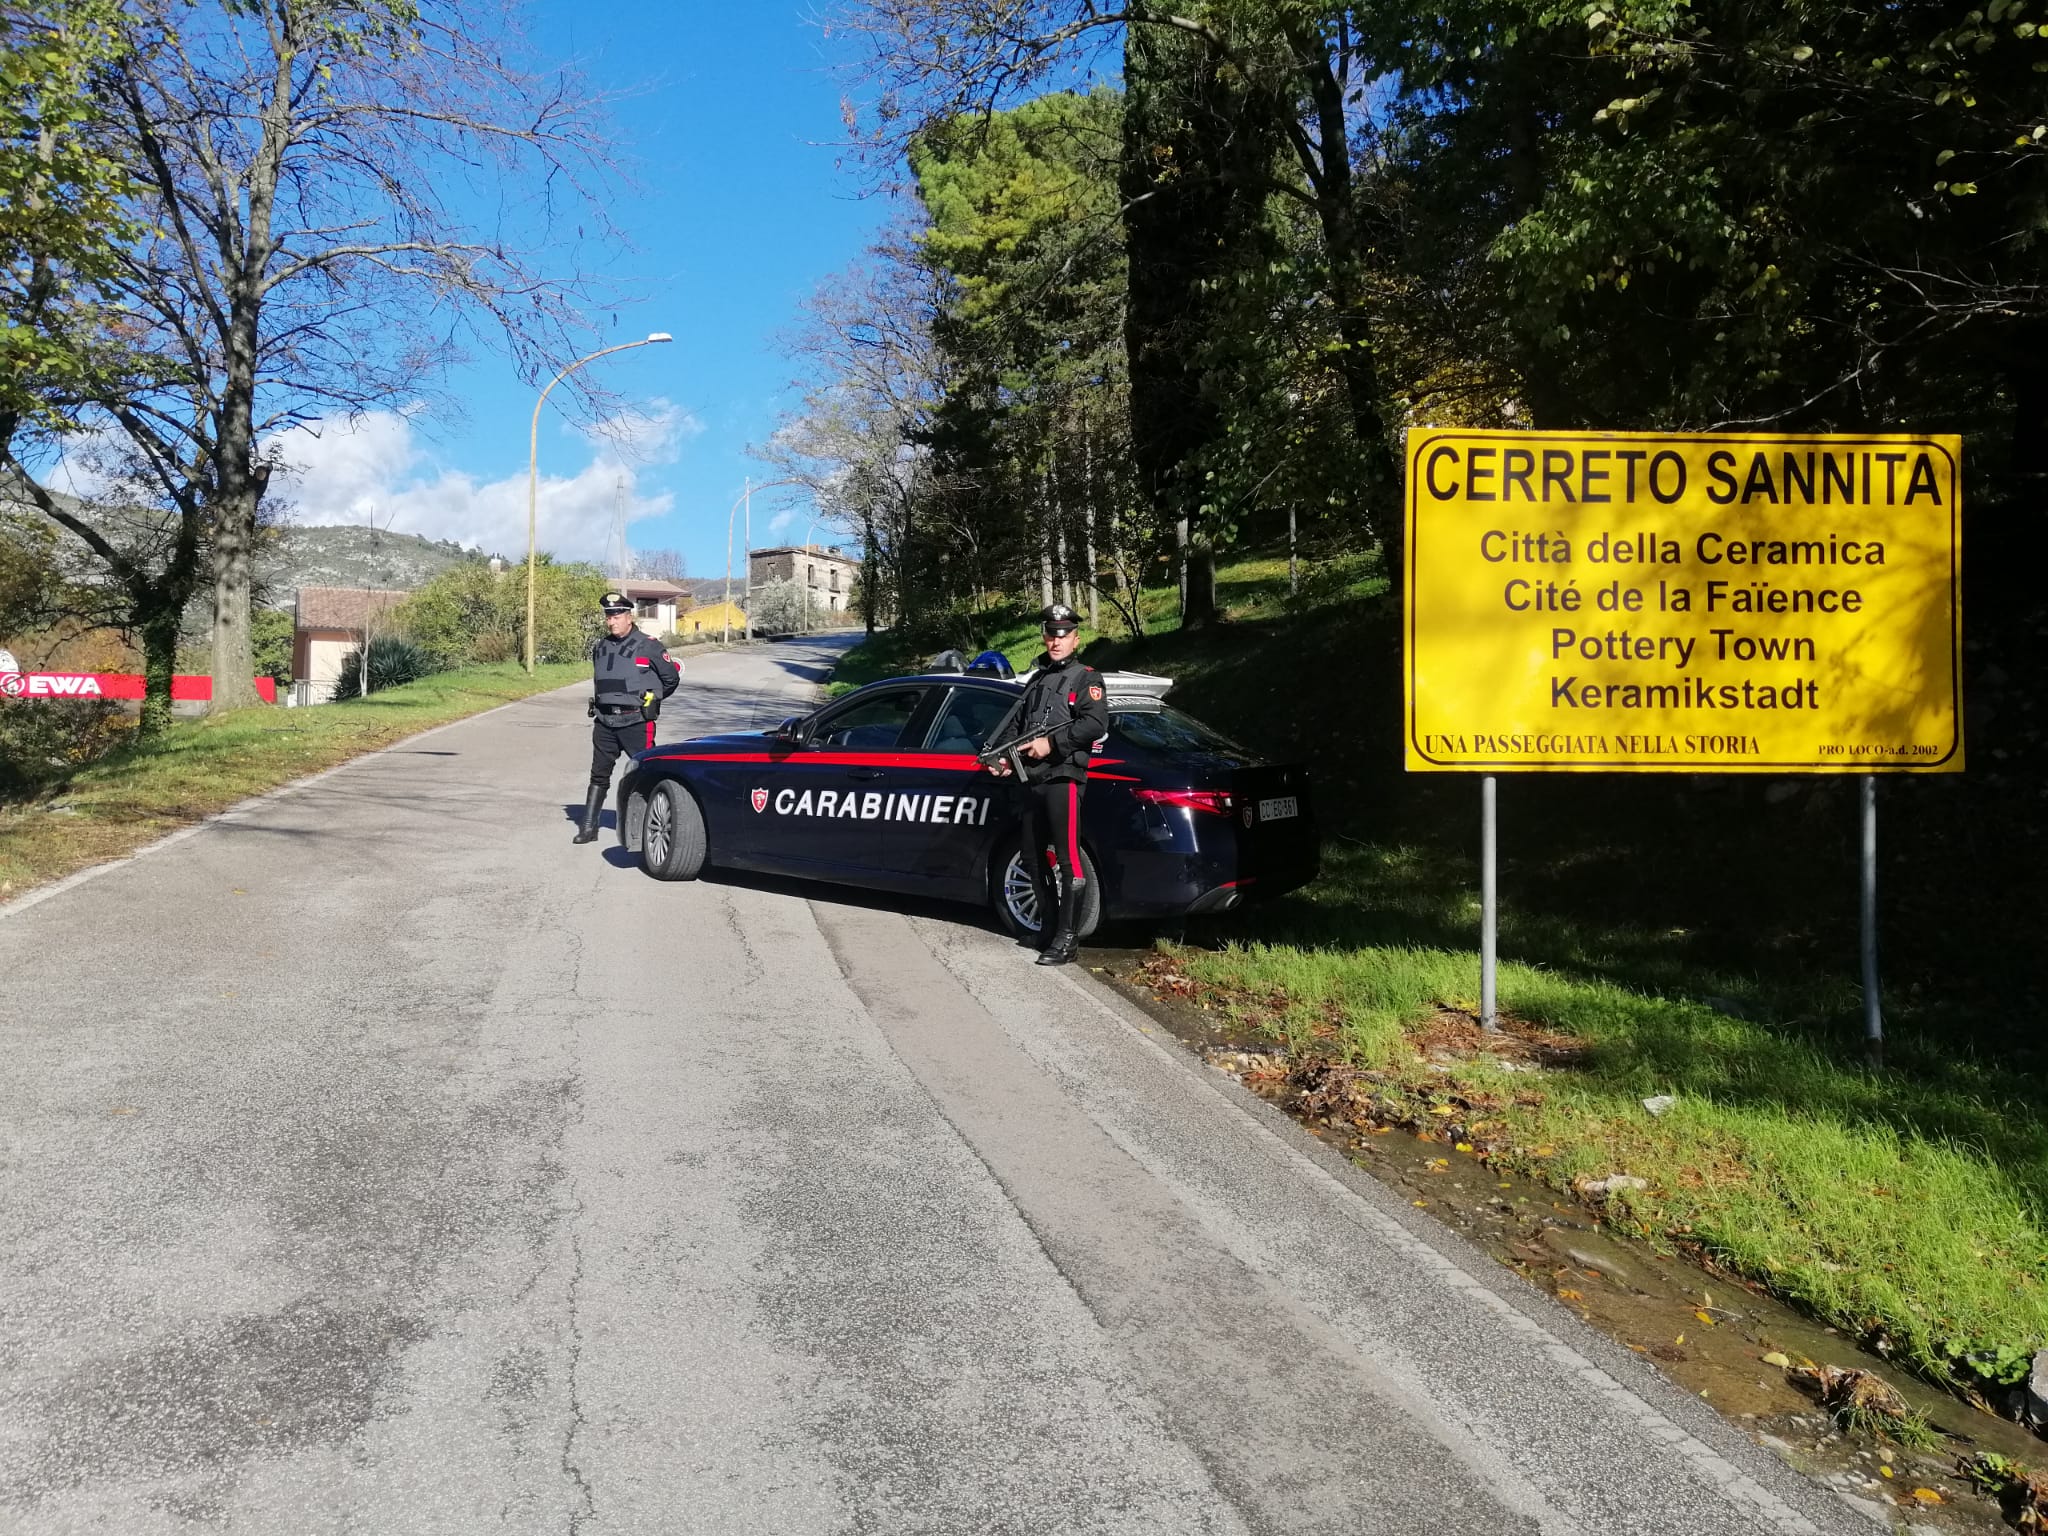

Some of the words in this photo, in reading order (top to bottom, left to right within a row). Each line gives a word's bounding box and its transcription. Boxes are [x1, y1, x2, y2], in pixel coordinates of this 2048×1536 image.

[1426, 446, 1687, 504] CERRETO
[1706, 451, 1942, 505] SANNITA
[1480, 530, 1571, 563] Città
[1587, 532, 1681, 564] della
[1697, 532, 1885, 565] Ceramica
[1504, 579, 1581, 612] Cité
[1597, 581, 1643, 612] de
[1660, 581, 1691, 613] la
[1707, 581, 1862, 613] Faïence
[1552, 628, 1696, 669] Pottery
[1710, 629, 1816, 661] Town
[29, 675, 102, 694] EWA
[1551, 676, 1819, 709] Keramikstadt
[1425, 734, 1467, 753] UNA
[1473, 734, 1608, 754] PASSEGGIATA
[1615, 735, 1679, 754] NELLA
[1684, 735, 1760, 754] STORIA
[1818, 744, 1844, 755] PRO
[1912, 744, 1938, 755] 2002
[775, 788, 990, 826] CARABINIERI
